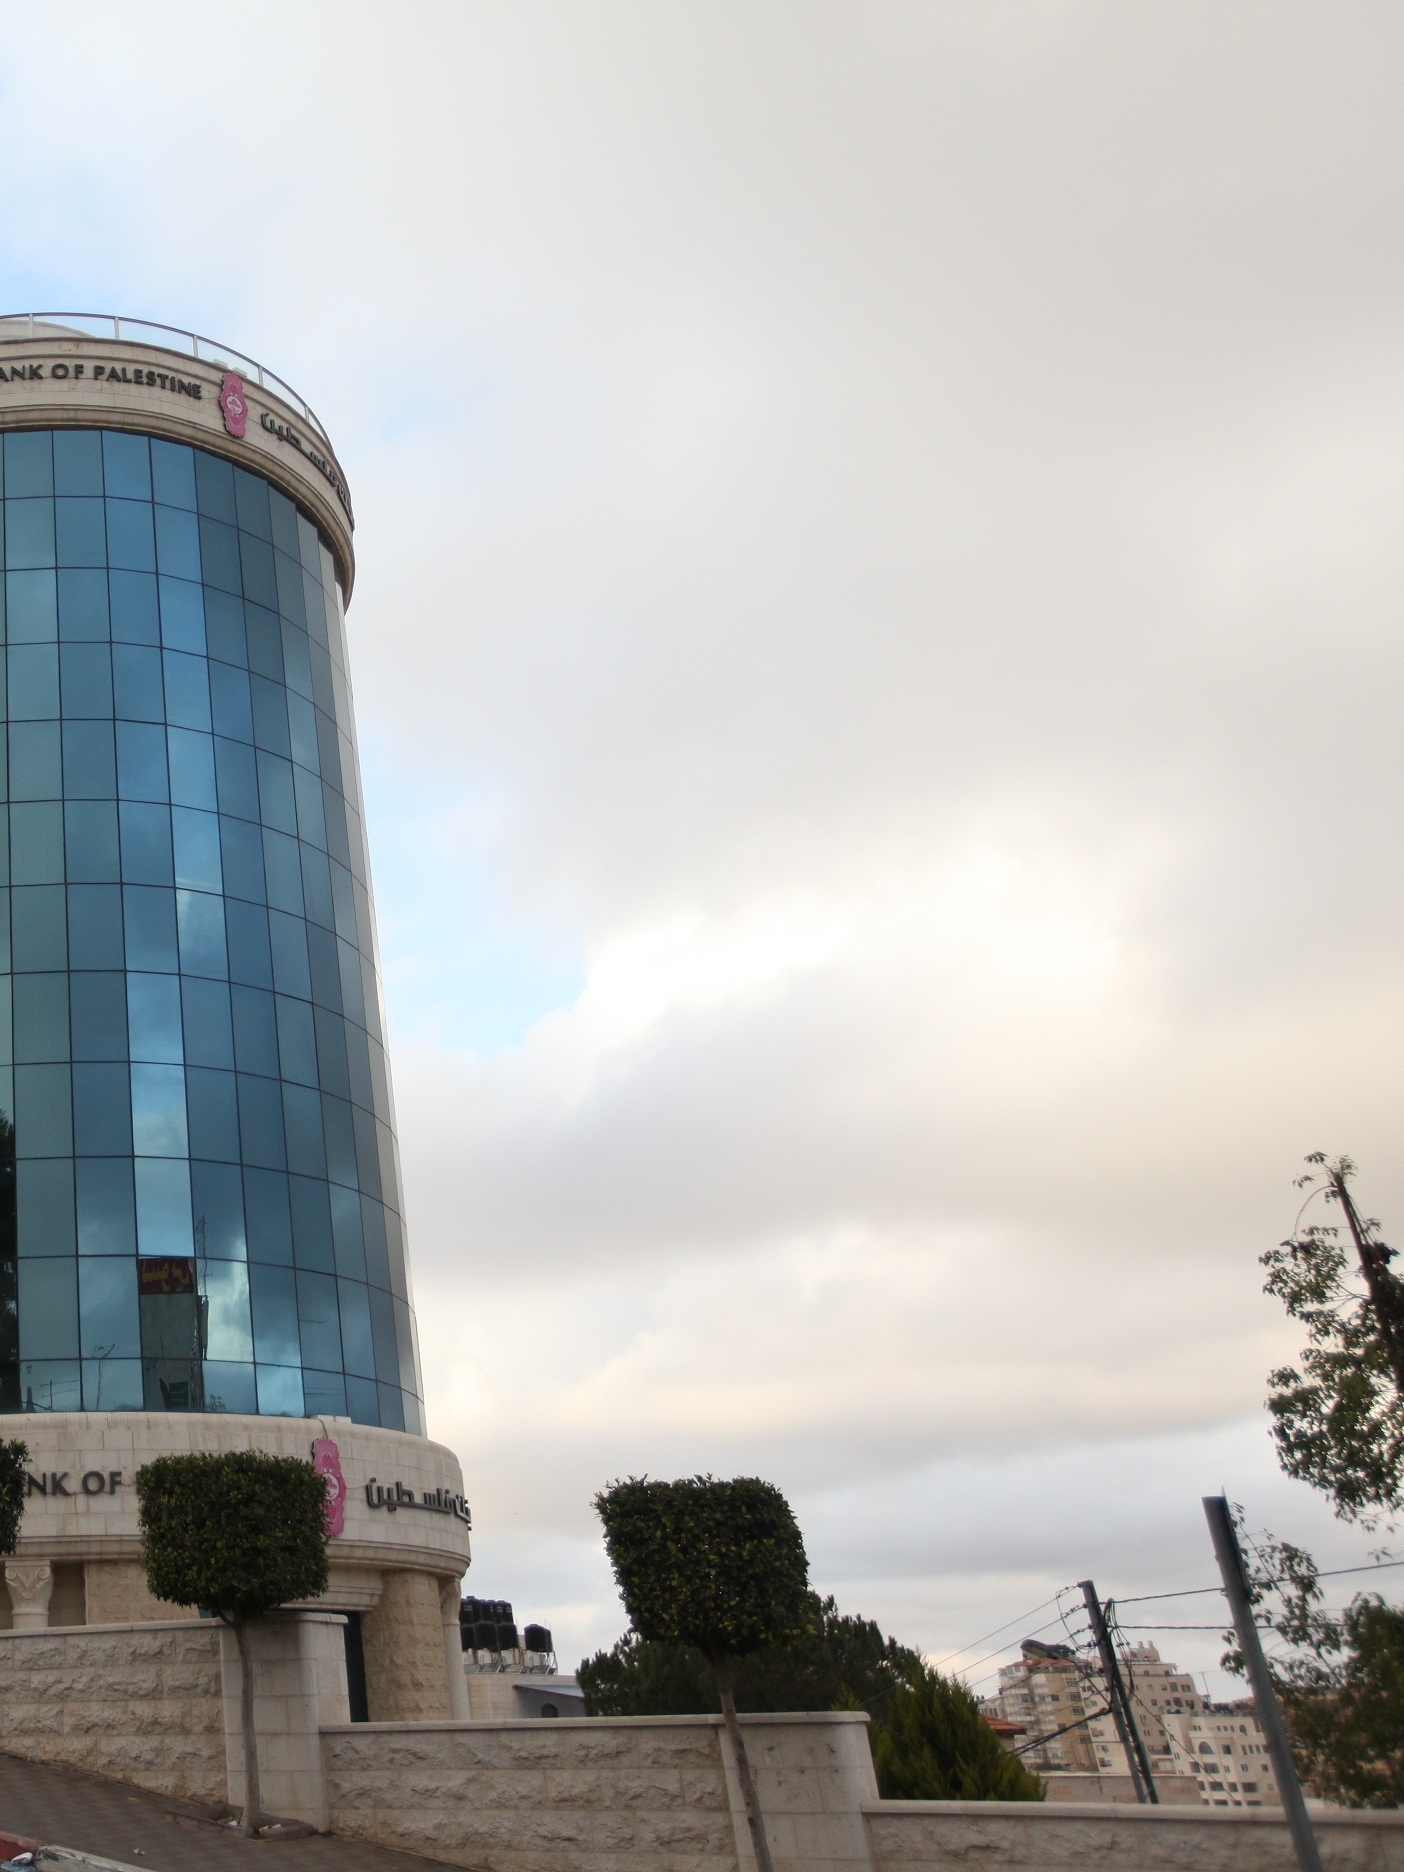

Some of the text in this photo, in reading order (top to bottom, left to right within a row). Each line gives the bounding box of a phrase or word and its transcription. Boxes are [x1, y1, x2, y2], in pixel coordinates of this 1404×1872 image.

[51, 363, 85, 380] OF
[93, 364, 203, 400] PALESTINE
[26, 1471, 72, 1497] NK
[81, 1470, 123, 1496] OF
[365, 1477, 455, 1515] فلسطين
